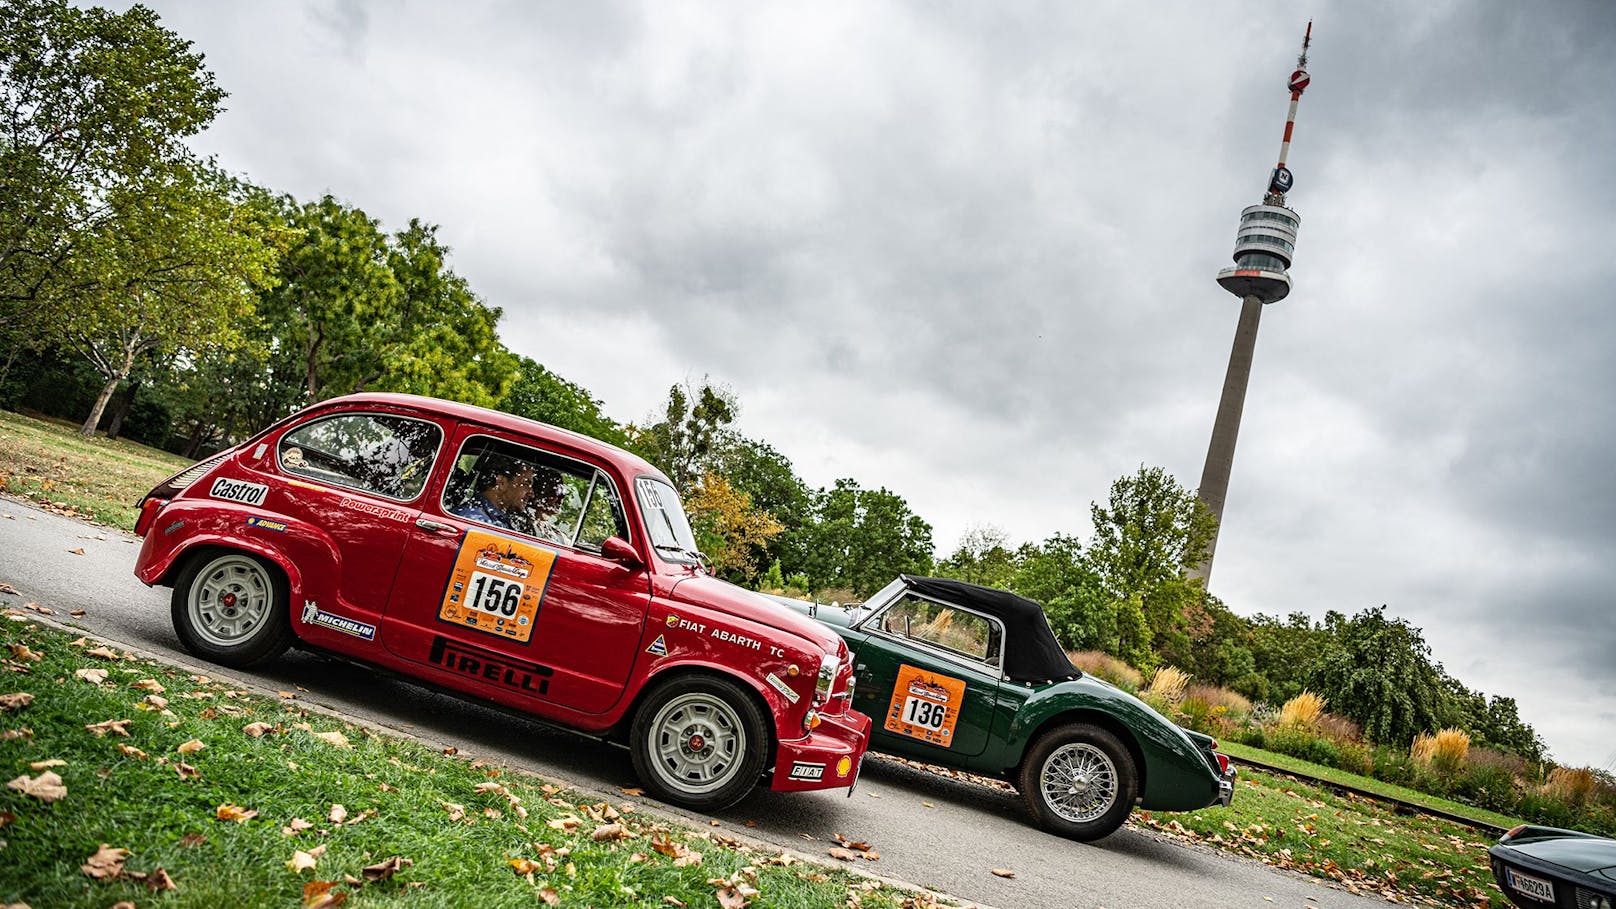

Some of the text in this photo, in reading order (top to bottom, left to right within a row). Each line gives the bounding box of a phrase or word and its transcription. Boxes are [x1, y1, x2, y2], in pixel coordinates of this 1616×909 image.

[211, 479, 267, 504] Castrol
[639, 480, 663, 508] 156
[339, 498, 411, 523] Powersprint
[256, 520, 287, 531] ADVANCE
[472, 576, 521, 616] 156
[317, 613, 373, 636] MICHELIN
[679, 619, 785, 658] FIAT ABARTH TC
[429, 635, 555, 695] PIRELLI
[909, 699, 945, 728] 136
[791, 766, 824, 778] FIAT
